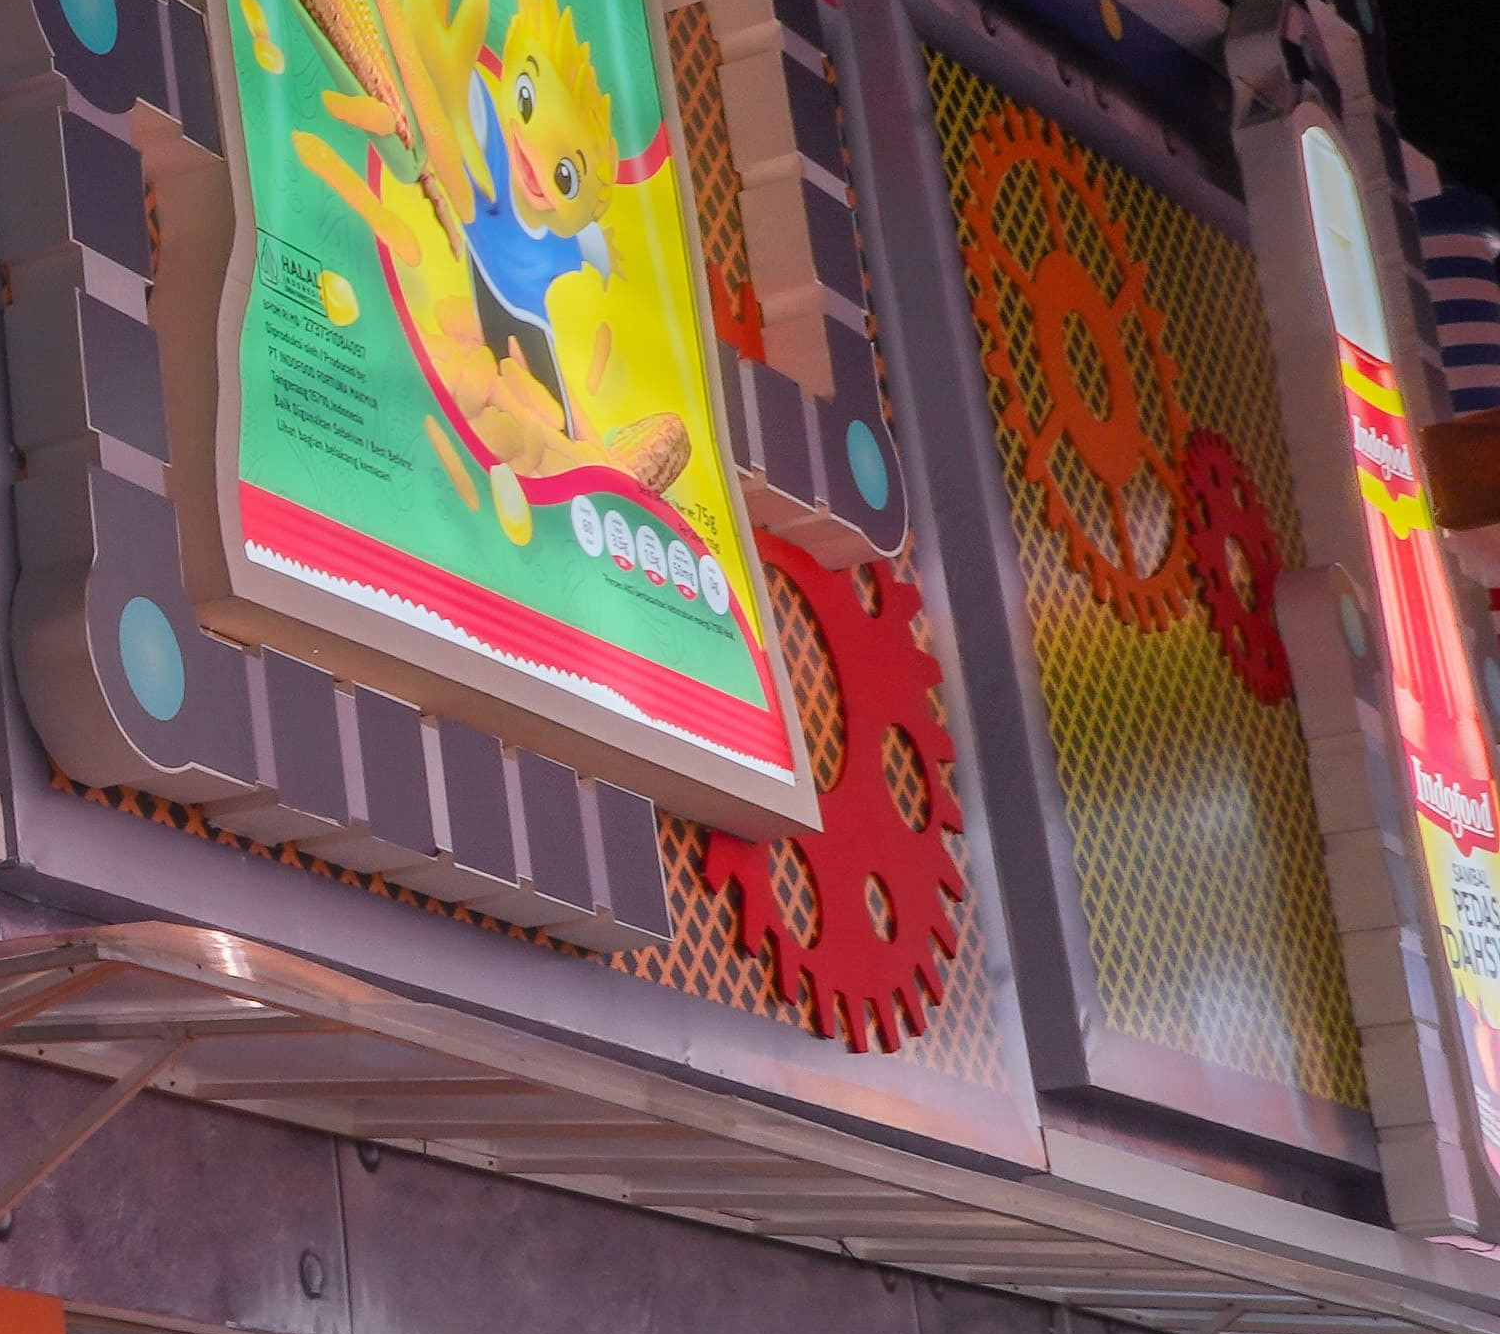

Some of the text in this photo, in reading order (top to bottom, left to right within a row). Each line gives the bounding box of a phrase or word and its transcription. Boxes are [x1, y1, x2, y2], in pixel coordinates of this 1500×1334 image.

[281, 253, 322, 290] HALAL
[1350, 413, 1415, 482] Indofood
[1410, 753, 1496, 840] Indofood
[1439, 923, 1500, 979] DAHS
